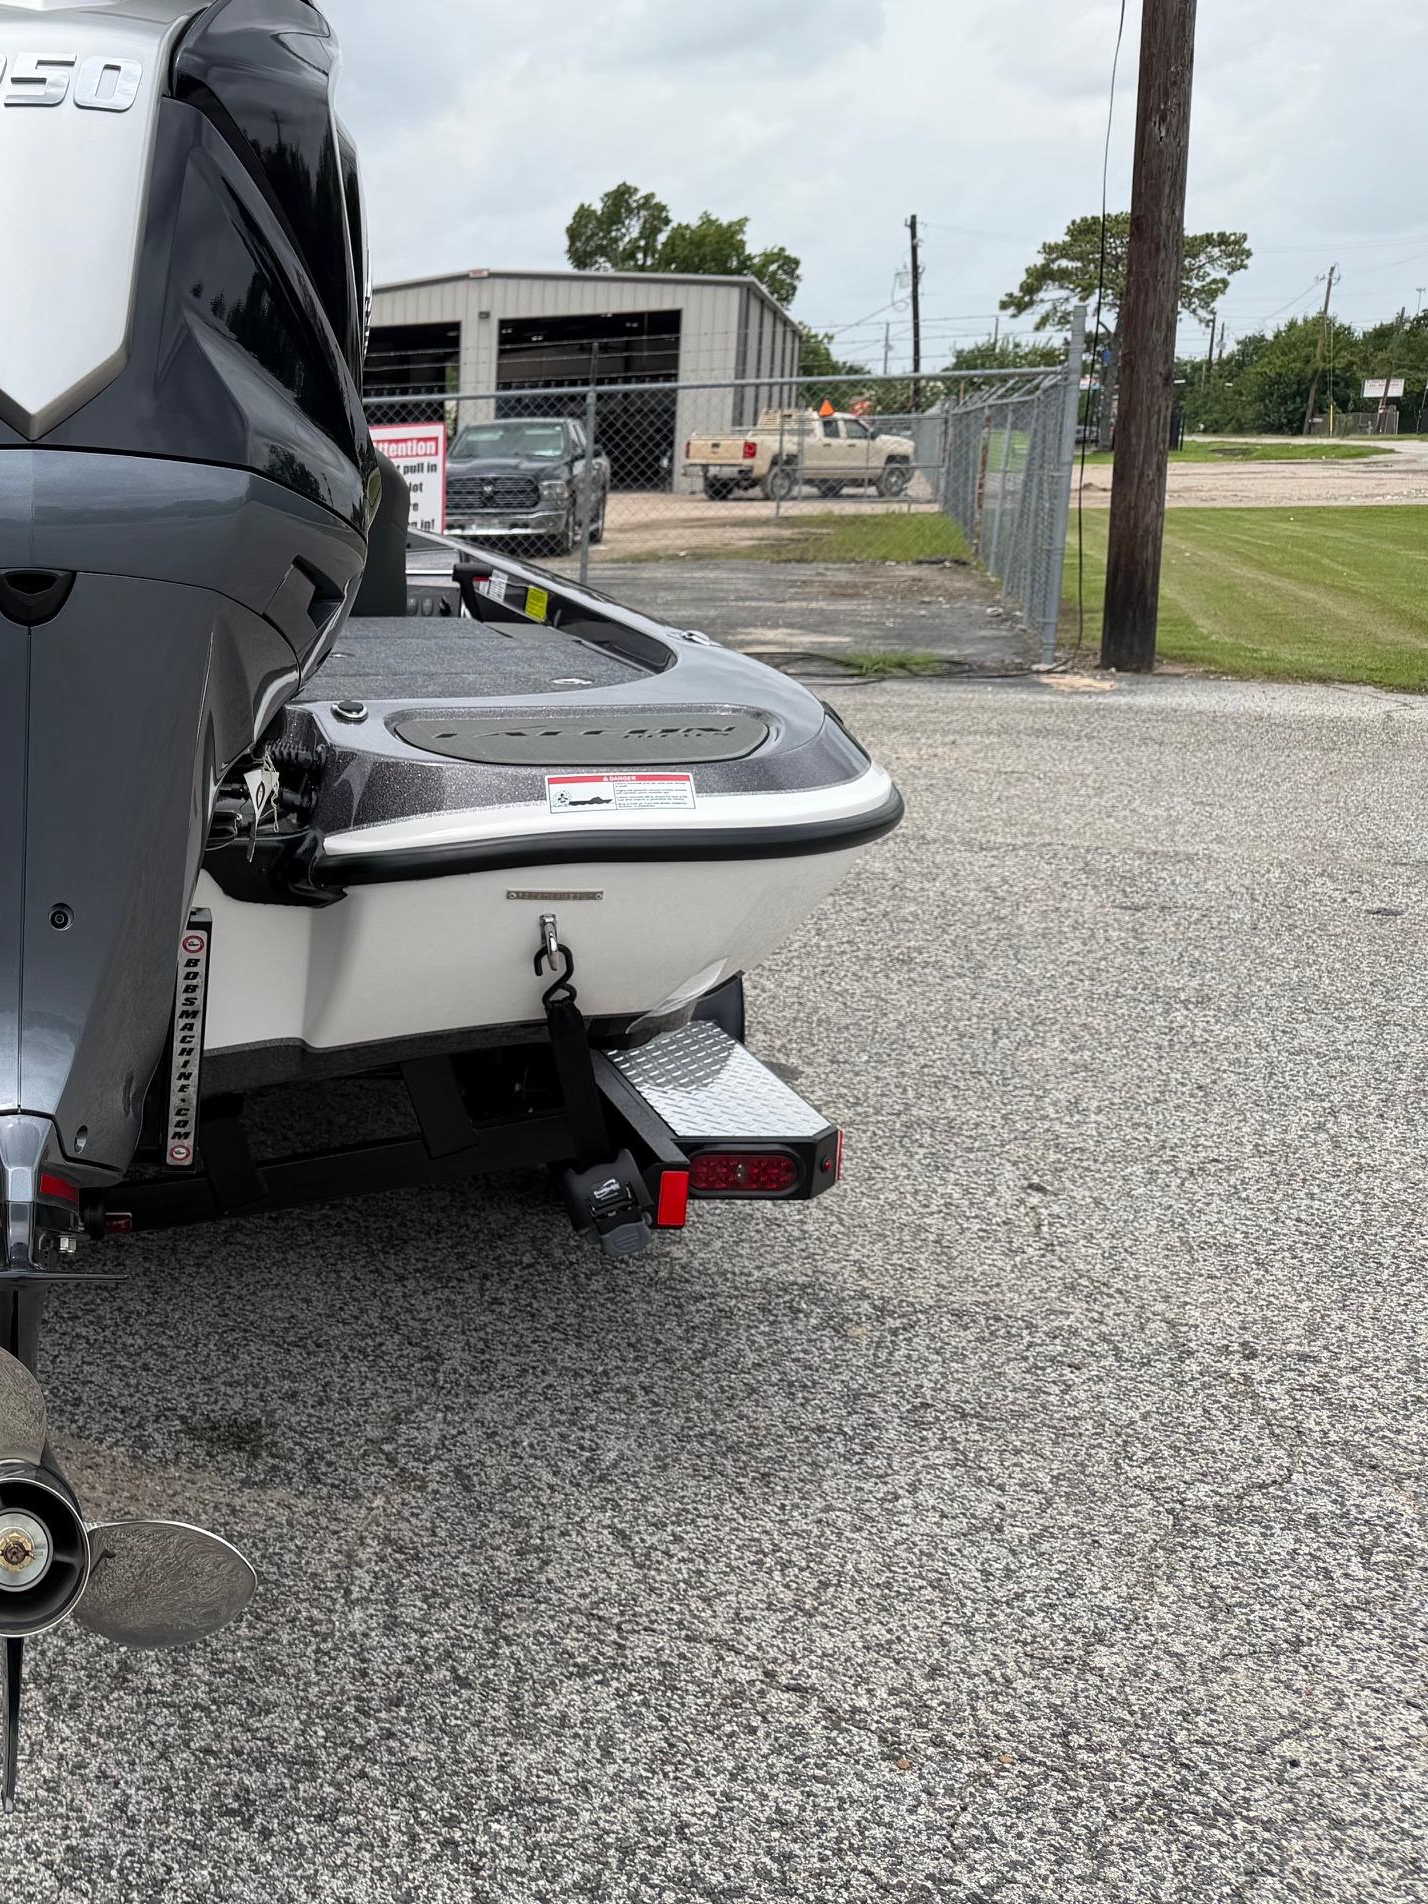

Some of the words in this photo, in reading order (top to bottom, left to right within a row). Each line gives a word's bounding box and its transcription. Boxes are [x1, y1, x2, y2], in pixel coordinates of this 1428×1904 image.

[374, 439, 436, 457] ttention
[403, 462, 424, 476] pull
[427, 461, 437, 474] in
[170, 958, 201, 1140] BOBSMACHINE.COM
